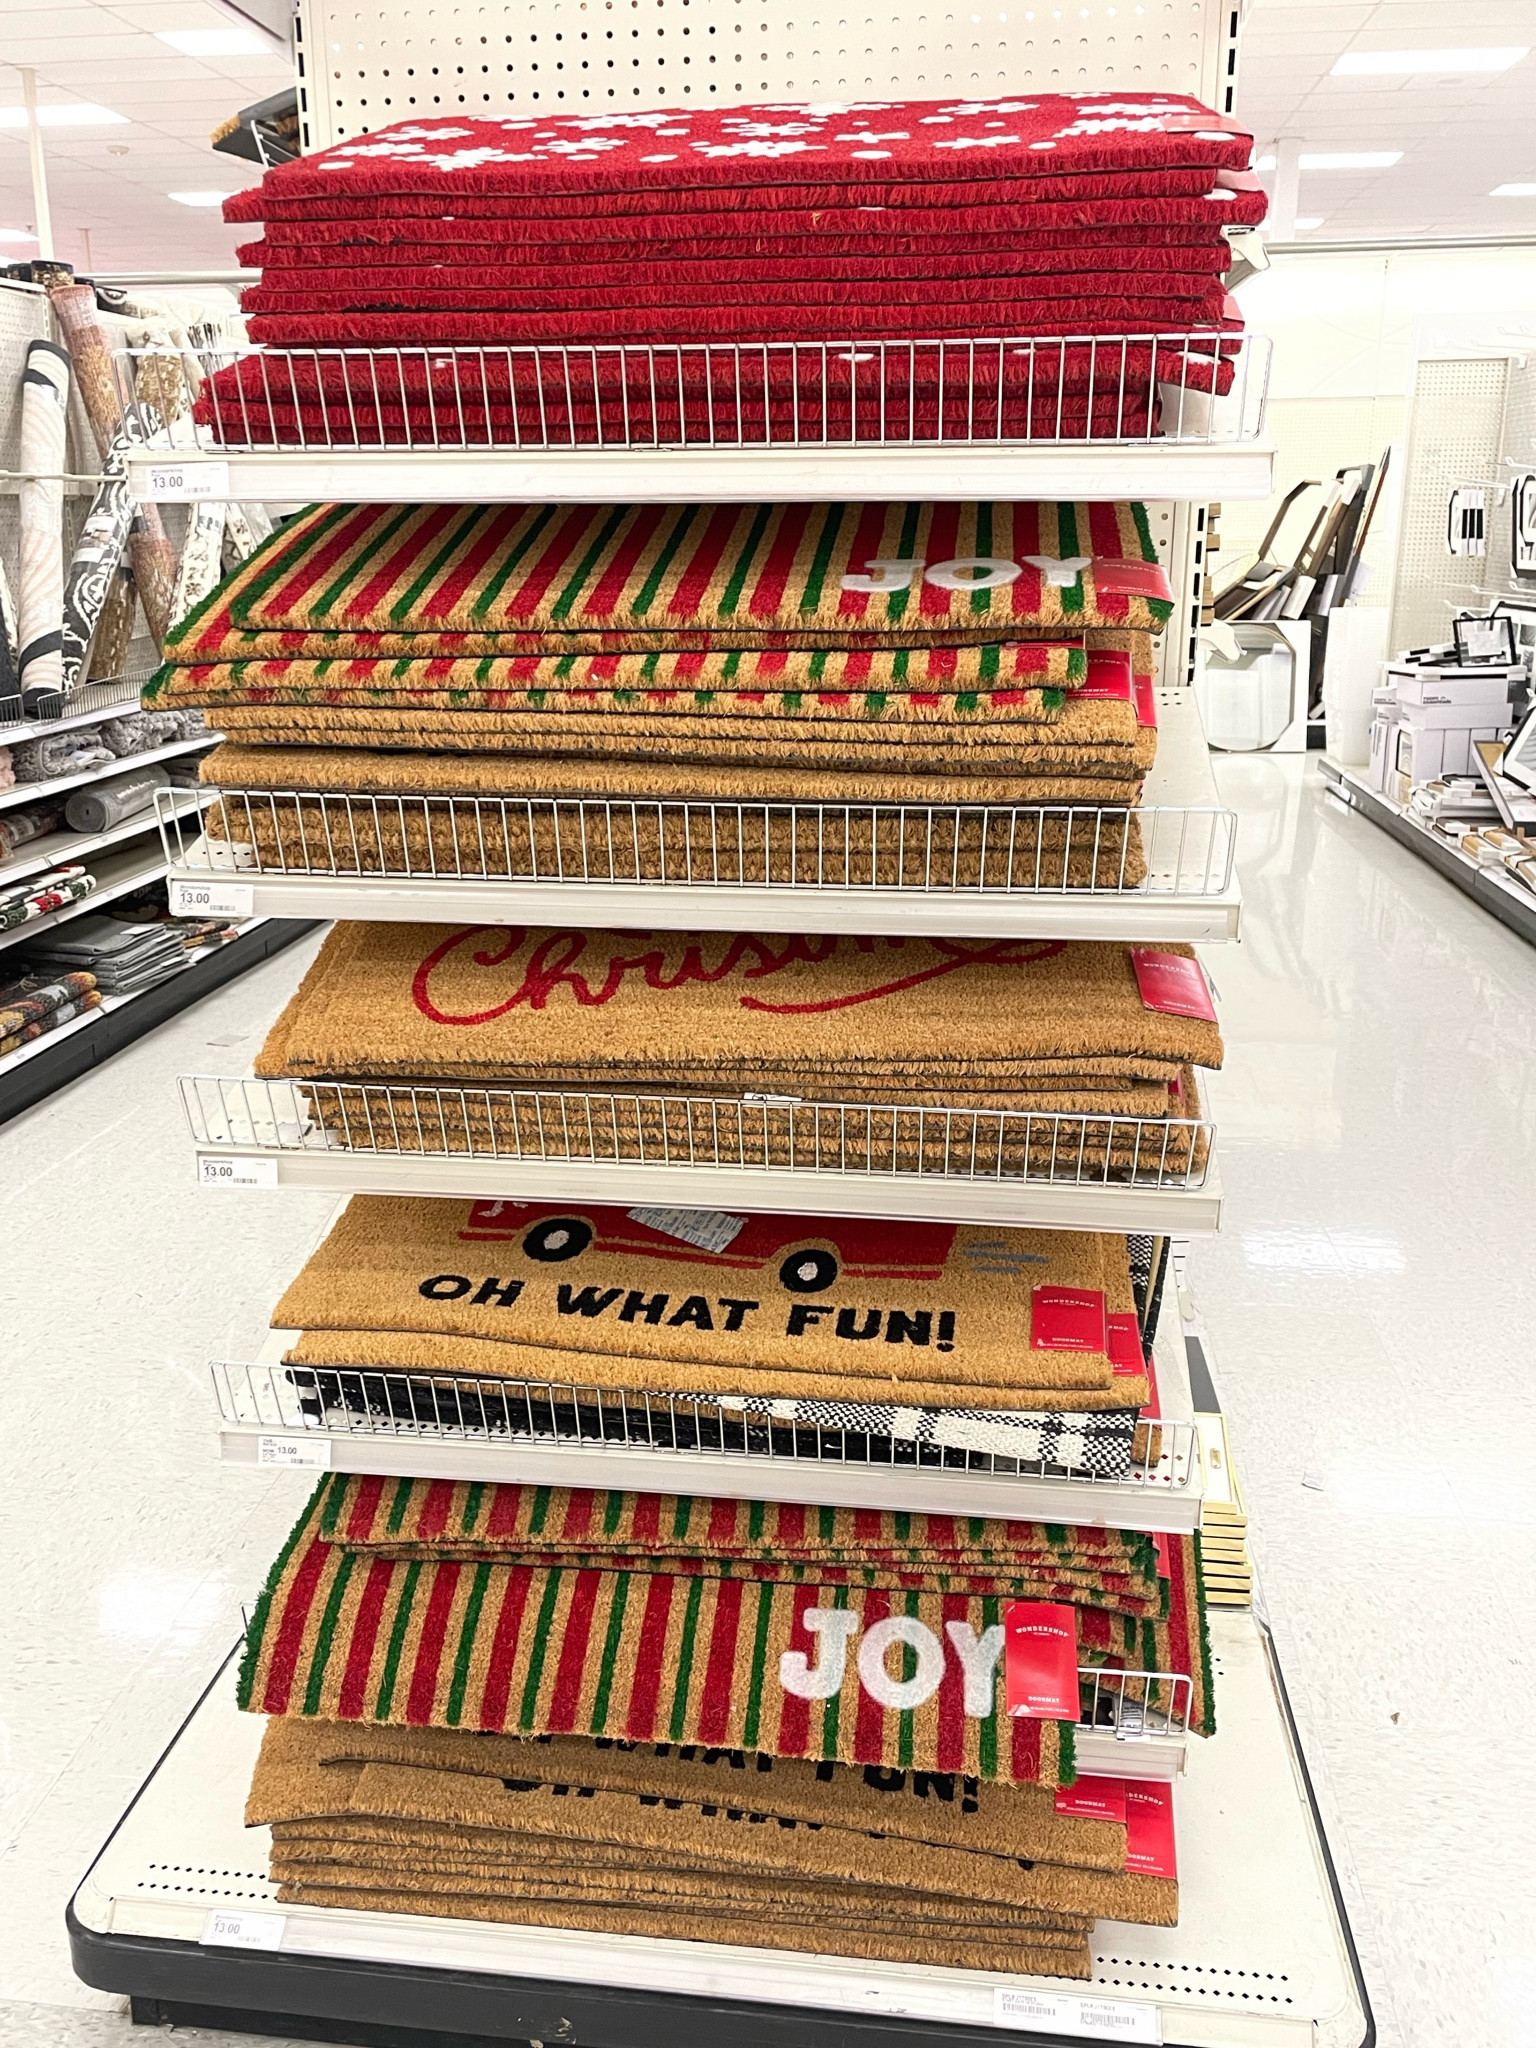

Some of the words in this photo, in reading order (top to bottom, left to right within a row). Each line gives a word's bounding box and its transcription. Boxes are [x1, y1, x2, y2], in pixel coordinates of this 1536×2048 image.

[152, 476, 183, 488] 13.00
[840, 555, 1092, 592] JOY
[180, 892, 210, 904] 13.00
[204, 1166, 233, 1177] 13.00
[418, 1274, 525, 1307] OH
[556, 1283, 760, 1332] WHAT
[786, 1304, 956, 1353] FUN!
[277, 1446, 297, 1455] 13.00
[1015, 1625, 1069, 1638] WONDERSHOP
[779, 1607, 1006, 1719] JOY
[1028, 1696, 1060, 1704] DOORMAT
[1126, 1791, 1164, 1806] DERSHOP
[1127, 1853, 1155, 1862] OORMAT
